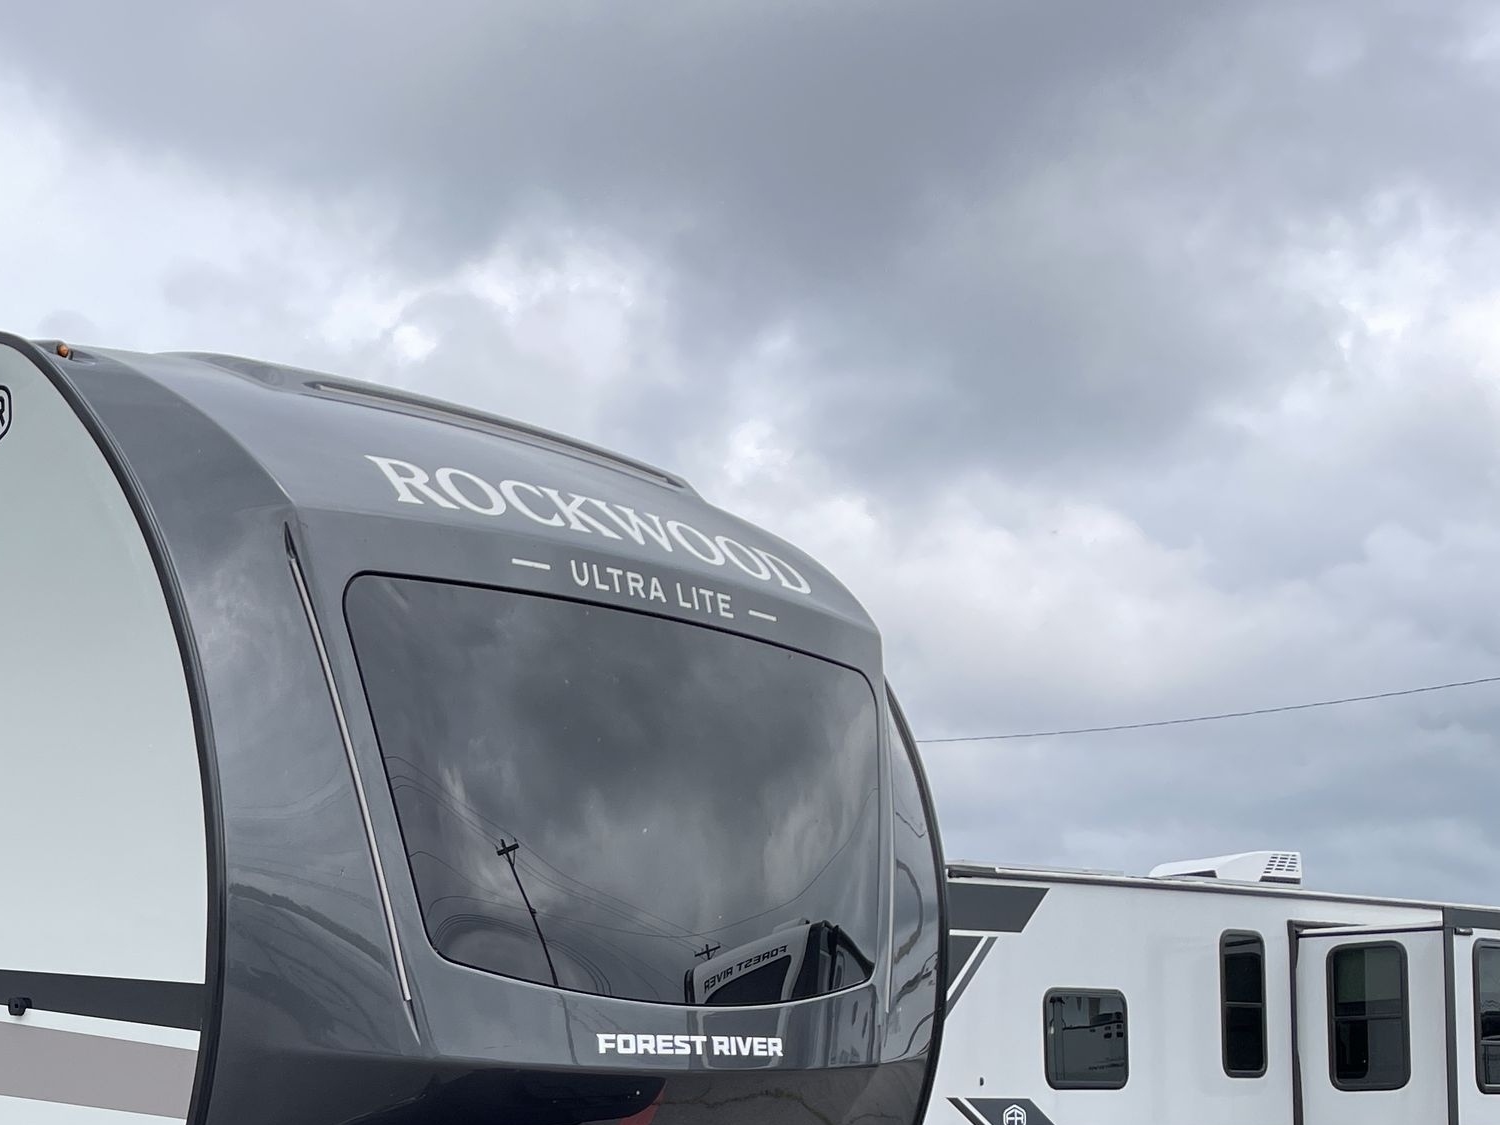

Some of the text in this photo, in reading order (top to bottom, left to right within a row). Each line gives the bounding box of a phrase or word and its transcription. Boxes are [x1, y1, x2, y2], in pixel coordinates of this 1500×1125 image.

[364, 455, 811, 594] ROCKWOOD
[570, 559, 734, 619] ULTRA LITE
[596, 1033, 783, 1056] FOREST RIVER
